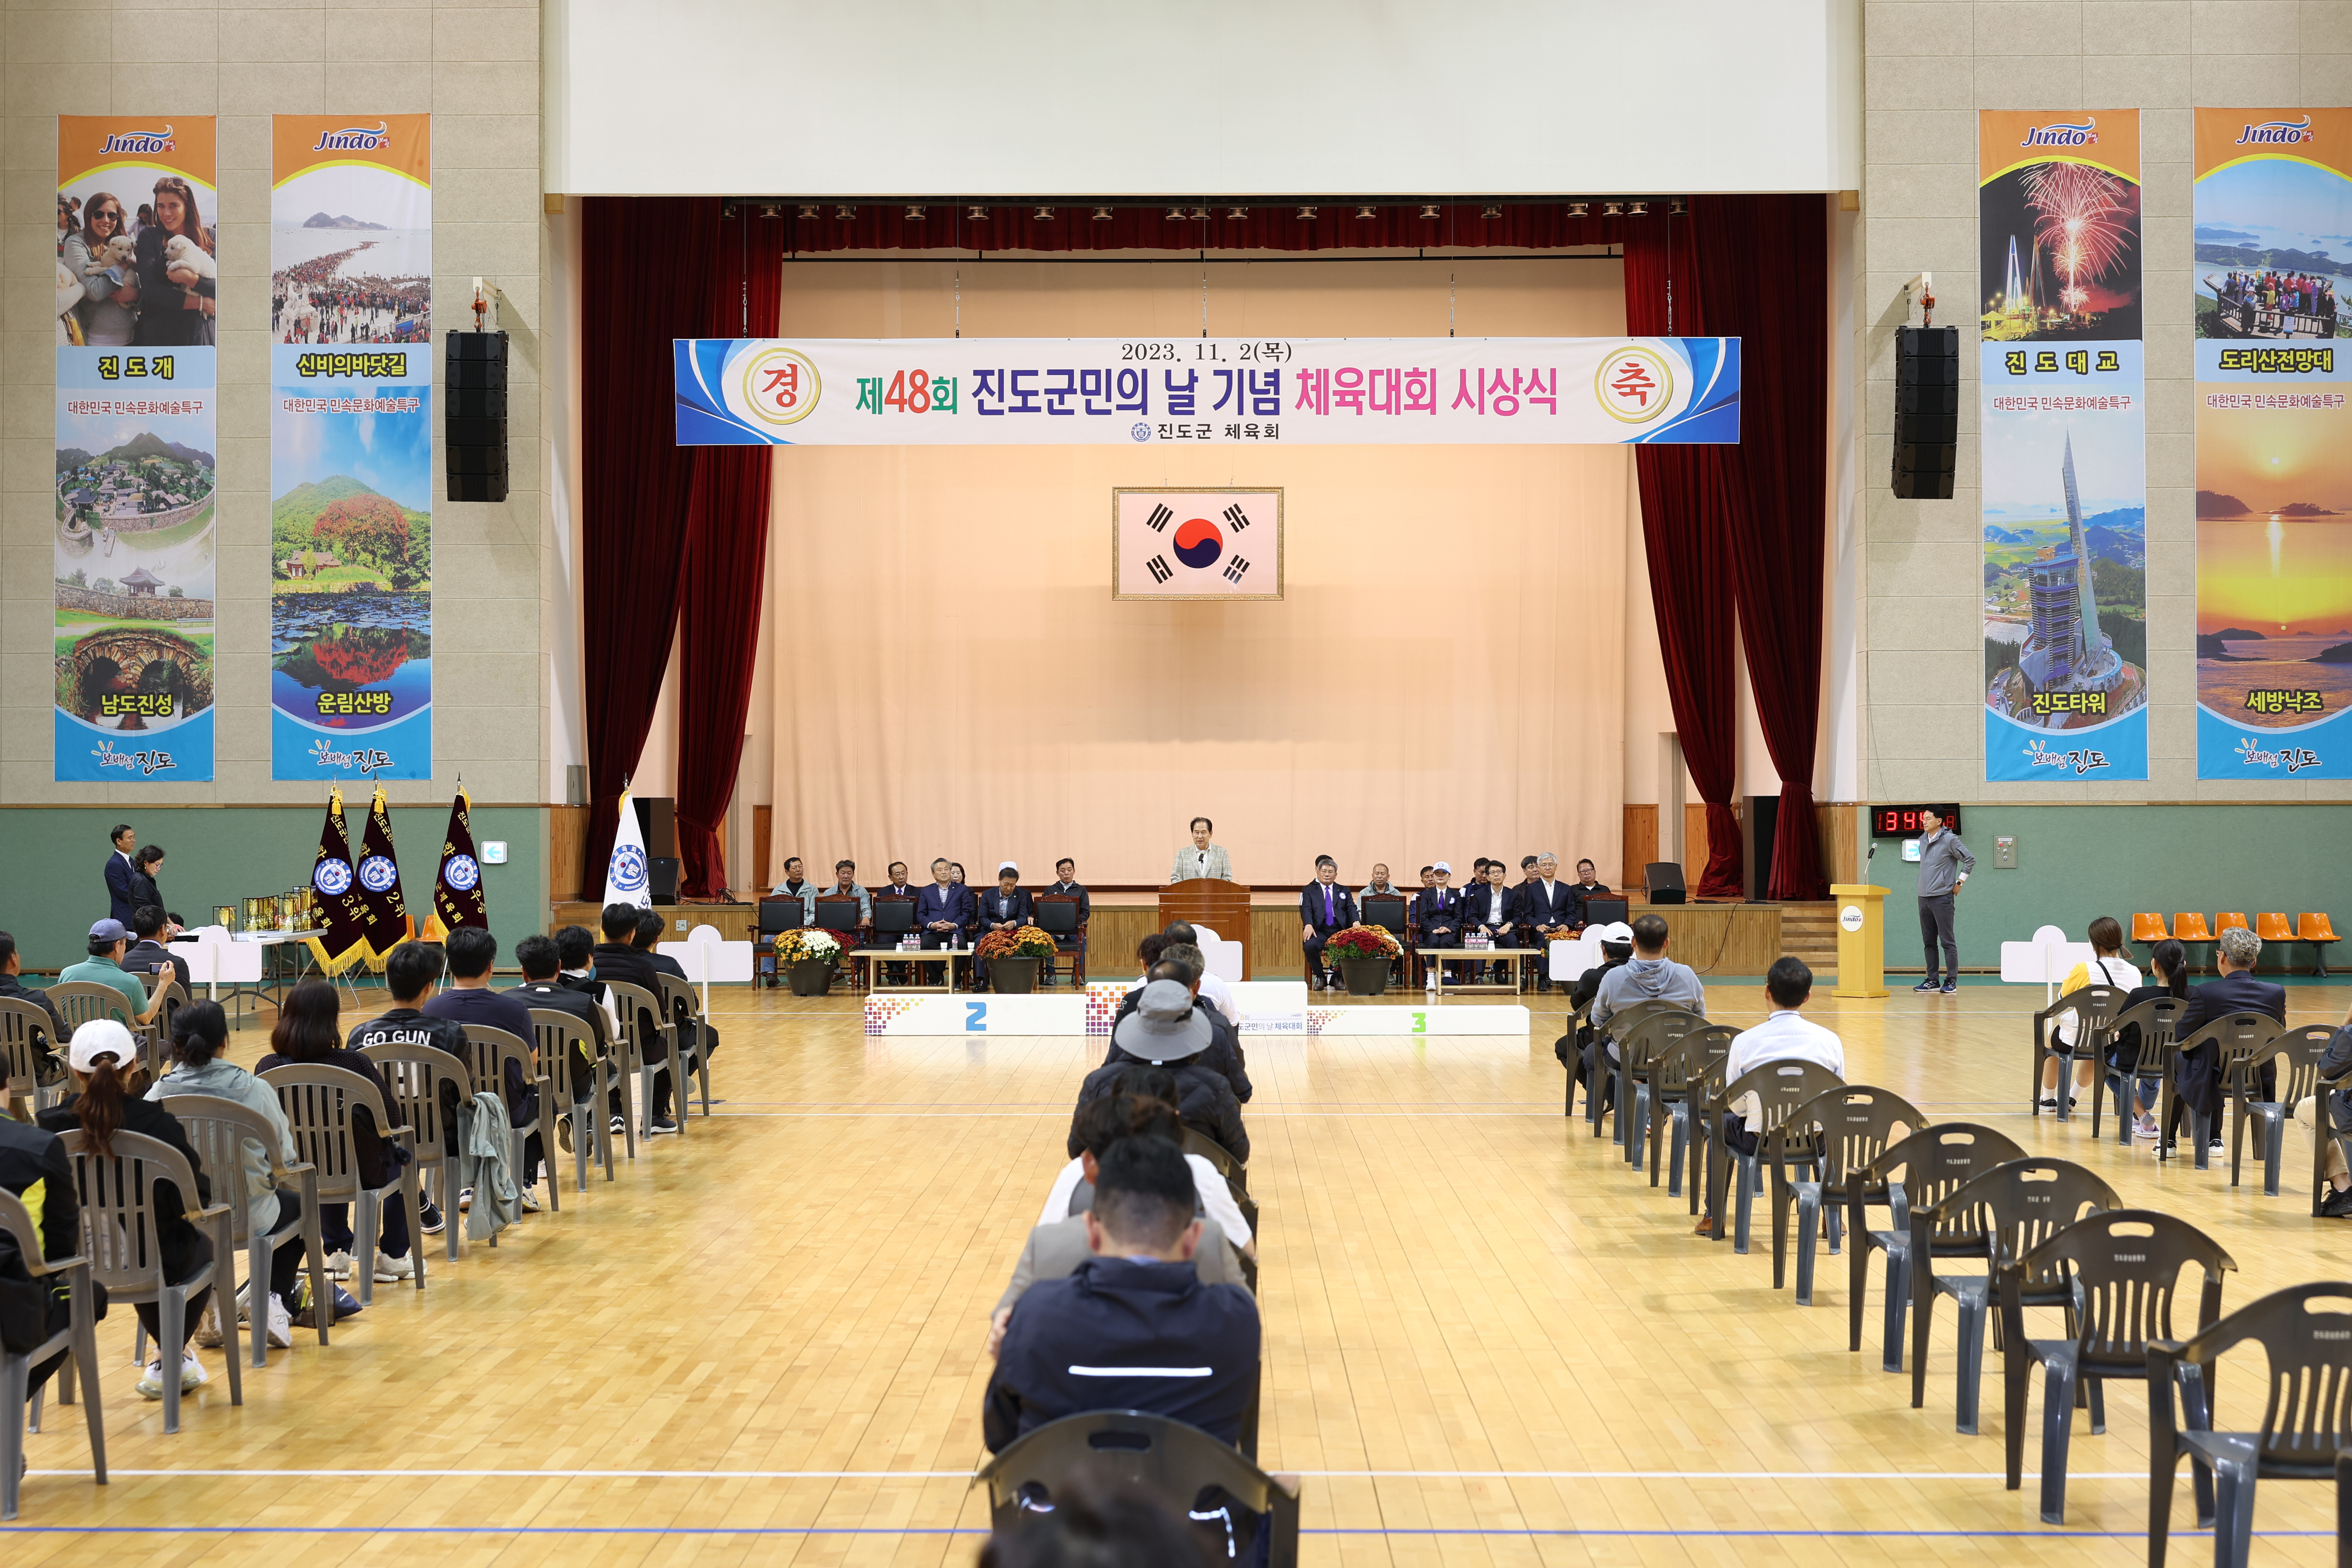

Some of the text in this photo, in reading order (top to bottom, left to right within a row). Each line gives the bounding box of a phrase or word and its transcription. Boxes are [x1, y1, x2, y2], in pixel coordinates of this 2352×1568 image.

[99, 134, 164, 154] Jindo
[313, 131, 378, 151] Jindo
[2020, 127, 2086, 147] Jindo
[2235, 124, 2302, 145] Jindo
[1121, 341, 1292, 363] 2023. 11. 2(목)
[2221, 349, 2333, 372] 도리산전망대
[297, 354, 406, 377] 신비의바닷길
[762, 363, 798, 408] 경
[855, 367, 1557, 416] 제48회 진도군민의 날 기념 체육대회 시상식
[1611, 362, 1656, 406] 축
[68, 401, 203, 415] 대한민국 민속문화예술특구
[284, 399, 419, 412] 대한민국 민속문화예술특구
[1994, 396, 2131, 410] 대한민국 민속문화예술특구
[2207, 394, 2345, 408] 대한민국 민속문화예술특구
[1157, 423, 1212, 440] 진도군
[1224, 423, 1279, 440] 체육회
[101, 694, 173, 716] 남도진성
[317, 692, 392, 714] 운림산방
[2033, 692, 2106, 714] 진도타워
[2246, 691, 2322, 713] 세방낙조
[101, 750, 176, 775] 보배섬 진도
[318, 749, 394, 773] 보배섬 진도
[2033, 749, 2109, 774] 보배섬 진도
[2244, 748, 2321, 772] 보배섬 진도
[966, 1002, 986, 1031] 2
[1275, 1022, 1302, 1030] 체육대회
[1412, 1013, 1426, 1032] 3
[362, 1030, 431, 1047] GO GUN
